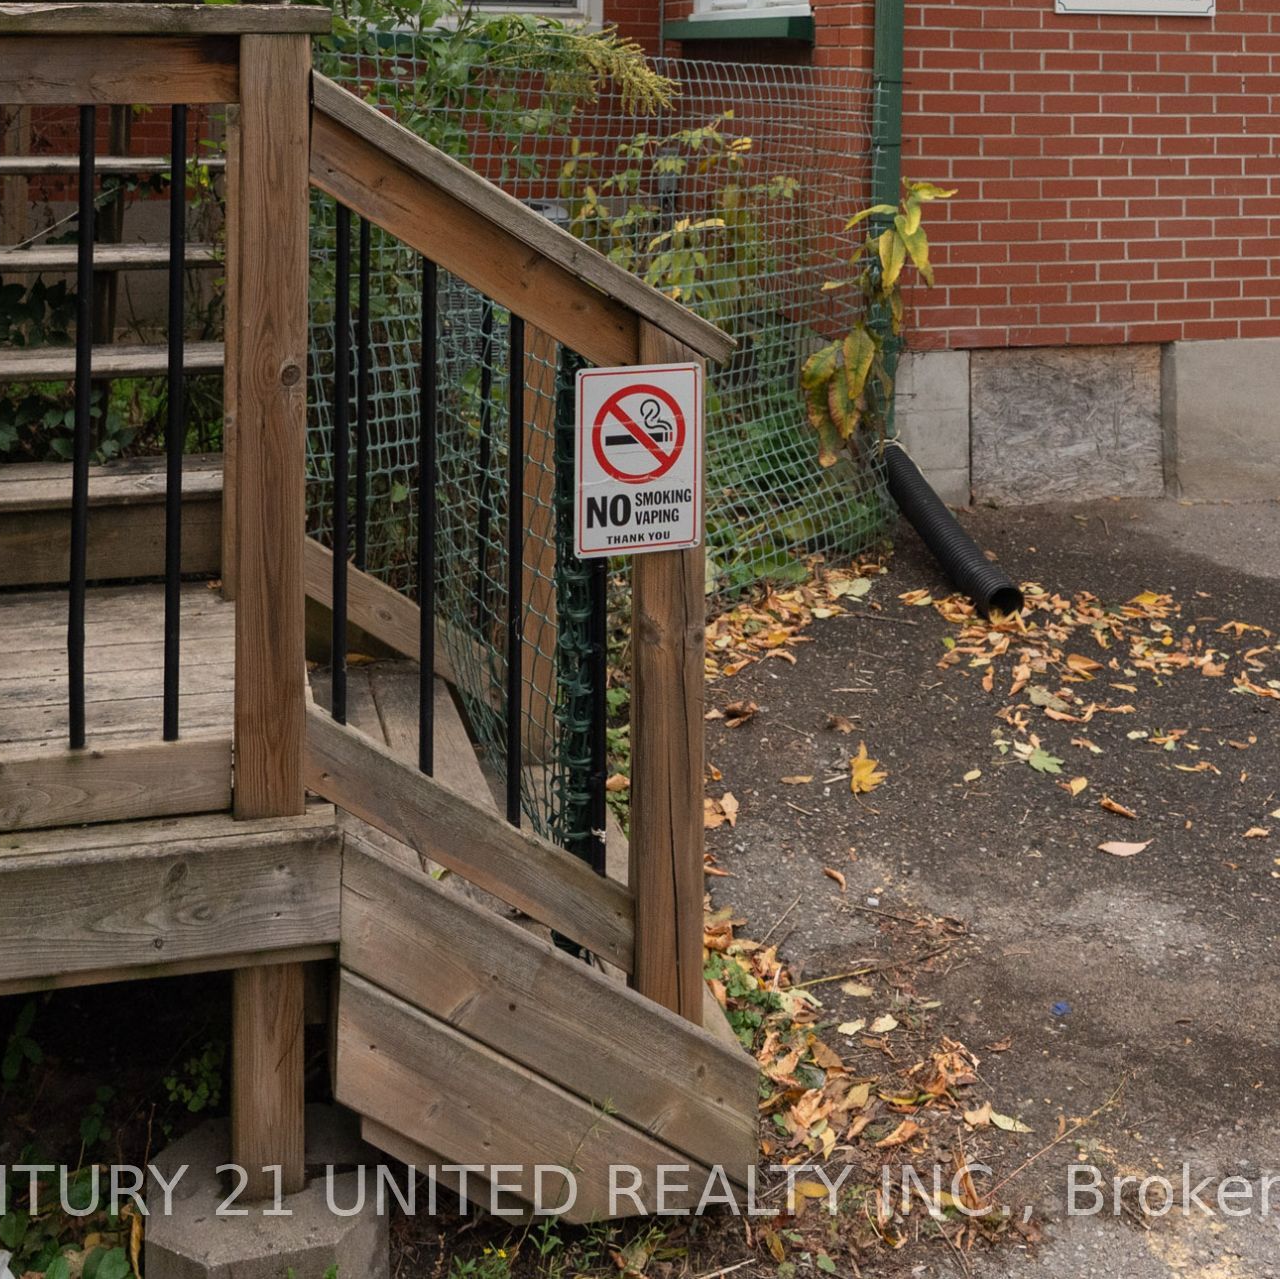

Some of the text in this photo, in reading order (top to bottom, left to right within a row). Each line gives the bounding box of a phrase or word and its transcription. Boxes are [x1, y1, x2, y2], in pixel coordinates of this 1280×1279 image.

[586, 488, 692, 529] NO SMOKING
[635, 508, 679, 525] VAPING
[606, 530, 670, 545] THANK YOU
